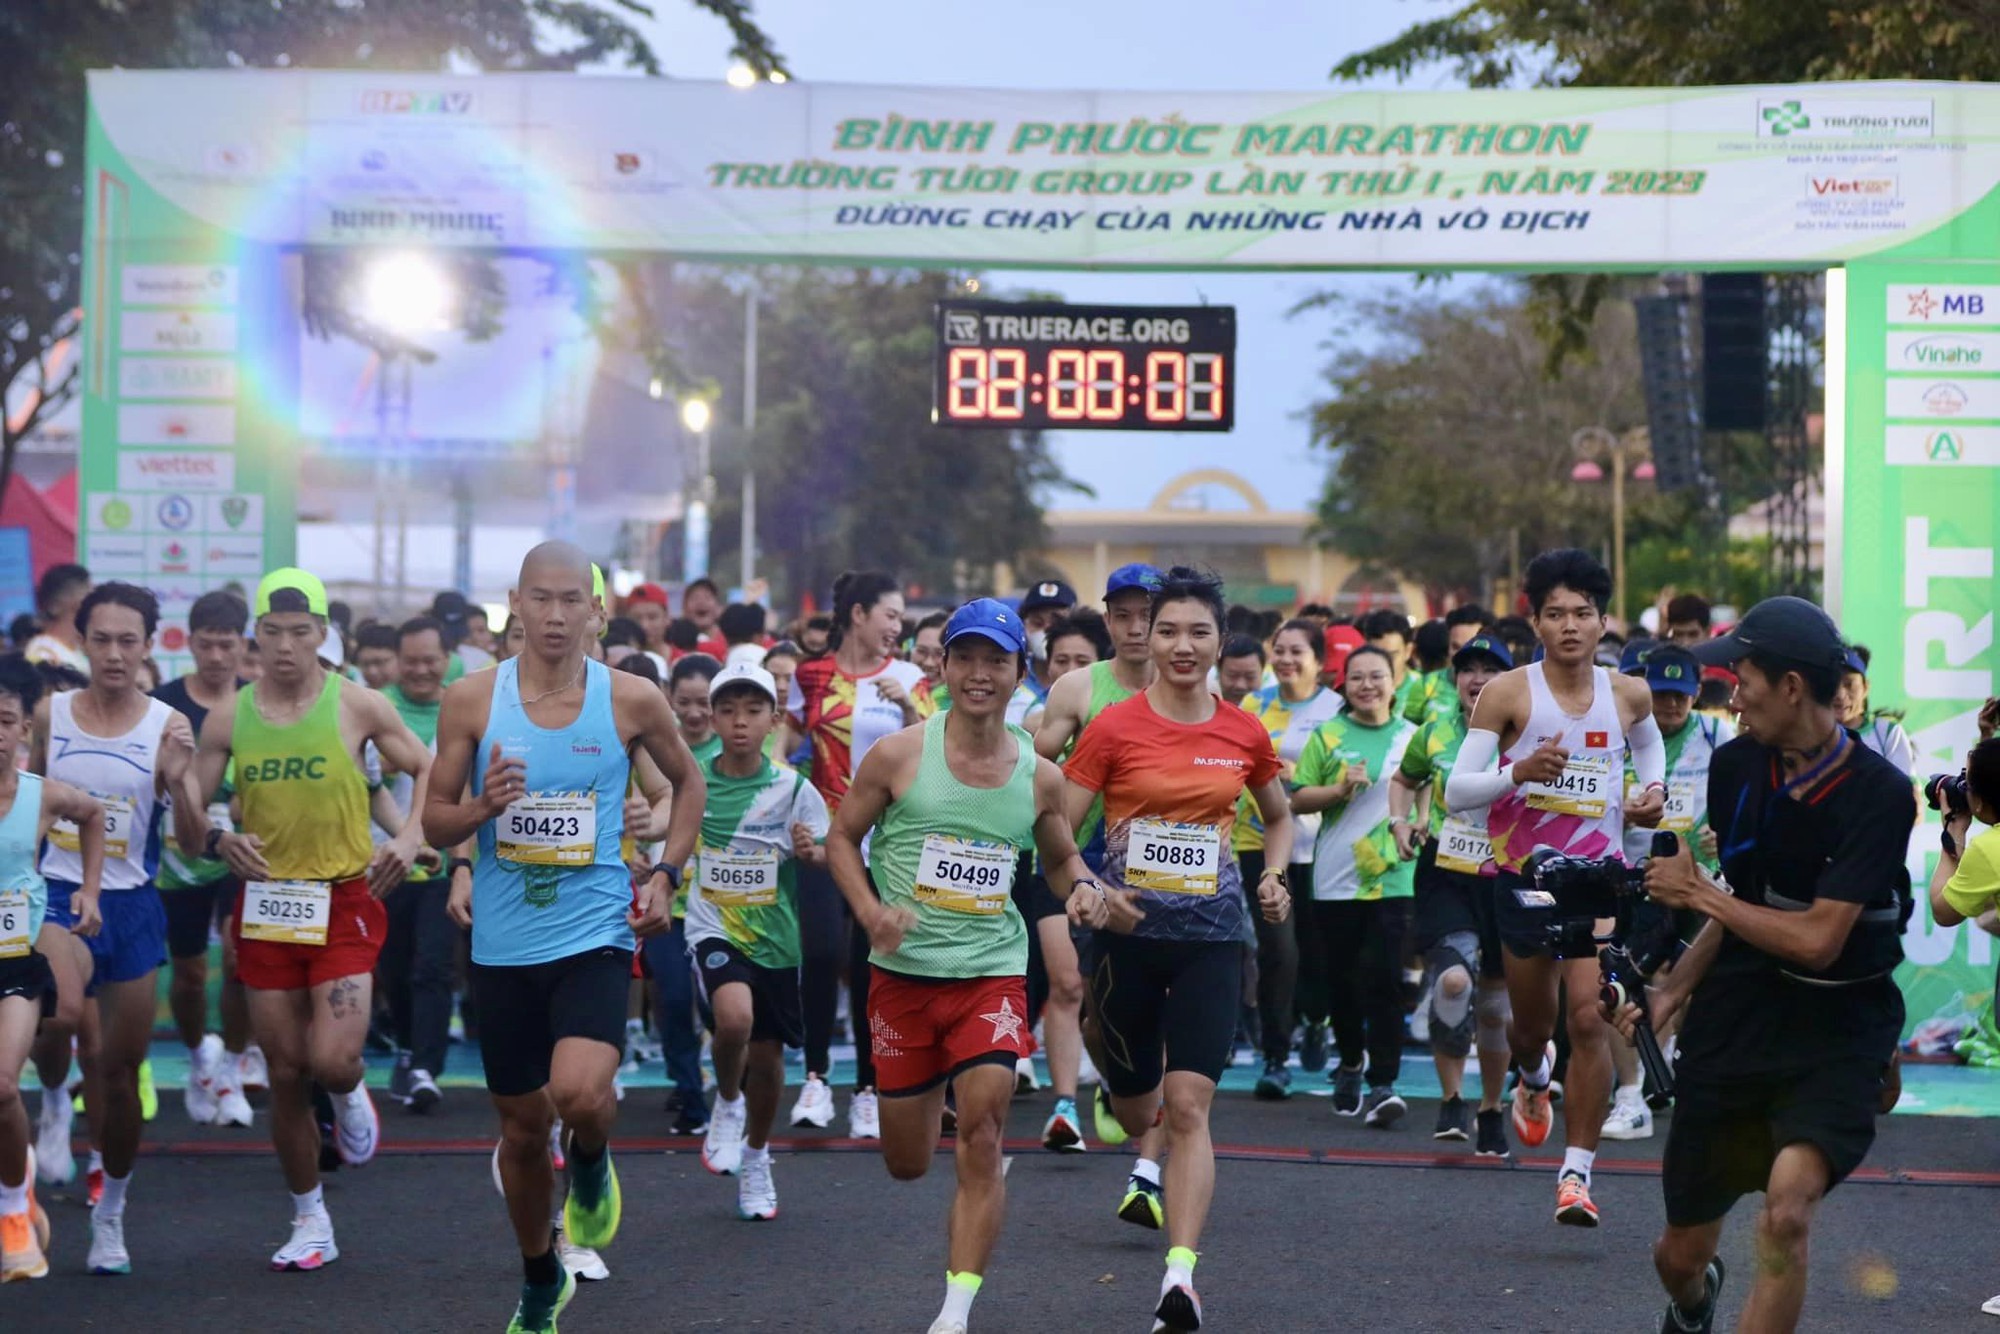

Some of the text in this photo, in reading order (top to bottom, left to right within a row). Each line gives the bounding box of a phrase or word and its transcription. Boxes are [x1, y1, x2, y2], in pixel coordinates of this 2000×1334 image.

[833, 110, 1592, 157] BÌNH PHƯỚC MARATHON
[706, 159, 896, 191] TRƯỜNG
[910, 164, 1020, 194] TƯƠI
[1030, 169, 1193, 196] GROUP
[1205, 162, 1306, 197] LẦN
[1317, 162, 1421, 196] THỨ
[1478, 163, 1597, 196] NĂM
[1602, 169, 1707, 196] 2023
[835, 203, 1590, 234] ĐƯỜNG CHẠY CỦA NHỮNG NHÀ VÔ ĐỊCH
[1943, 295, 1984, 314] MB
[984, 316, 1189, 342] TRUERACE.ORG
[949, 349, 1222, 420] 02:00:01
[243, 756, 327, 782] eBRC
[511, 816, 579, 837] 50423
[1143, 843, 1205, 866] 50883
[1449, 836, 1493, 857] 50170
[710, 867, 765, 885] 50658
[935, 860, 1000, 887] 50499
[257, 899, 315, 920] 50235
